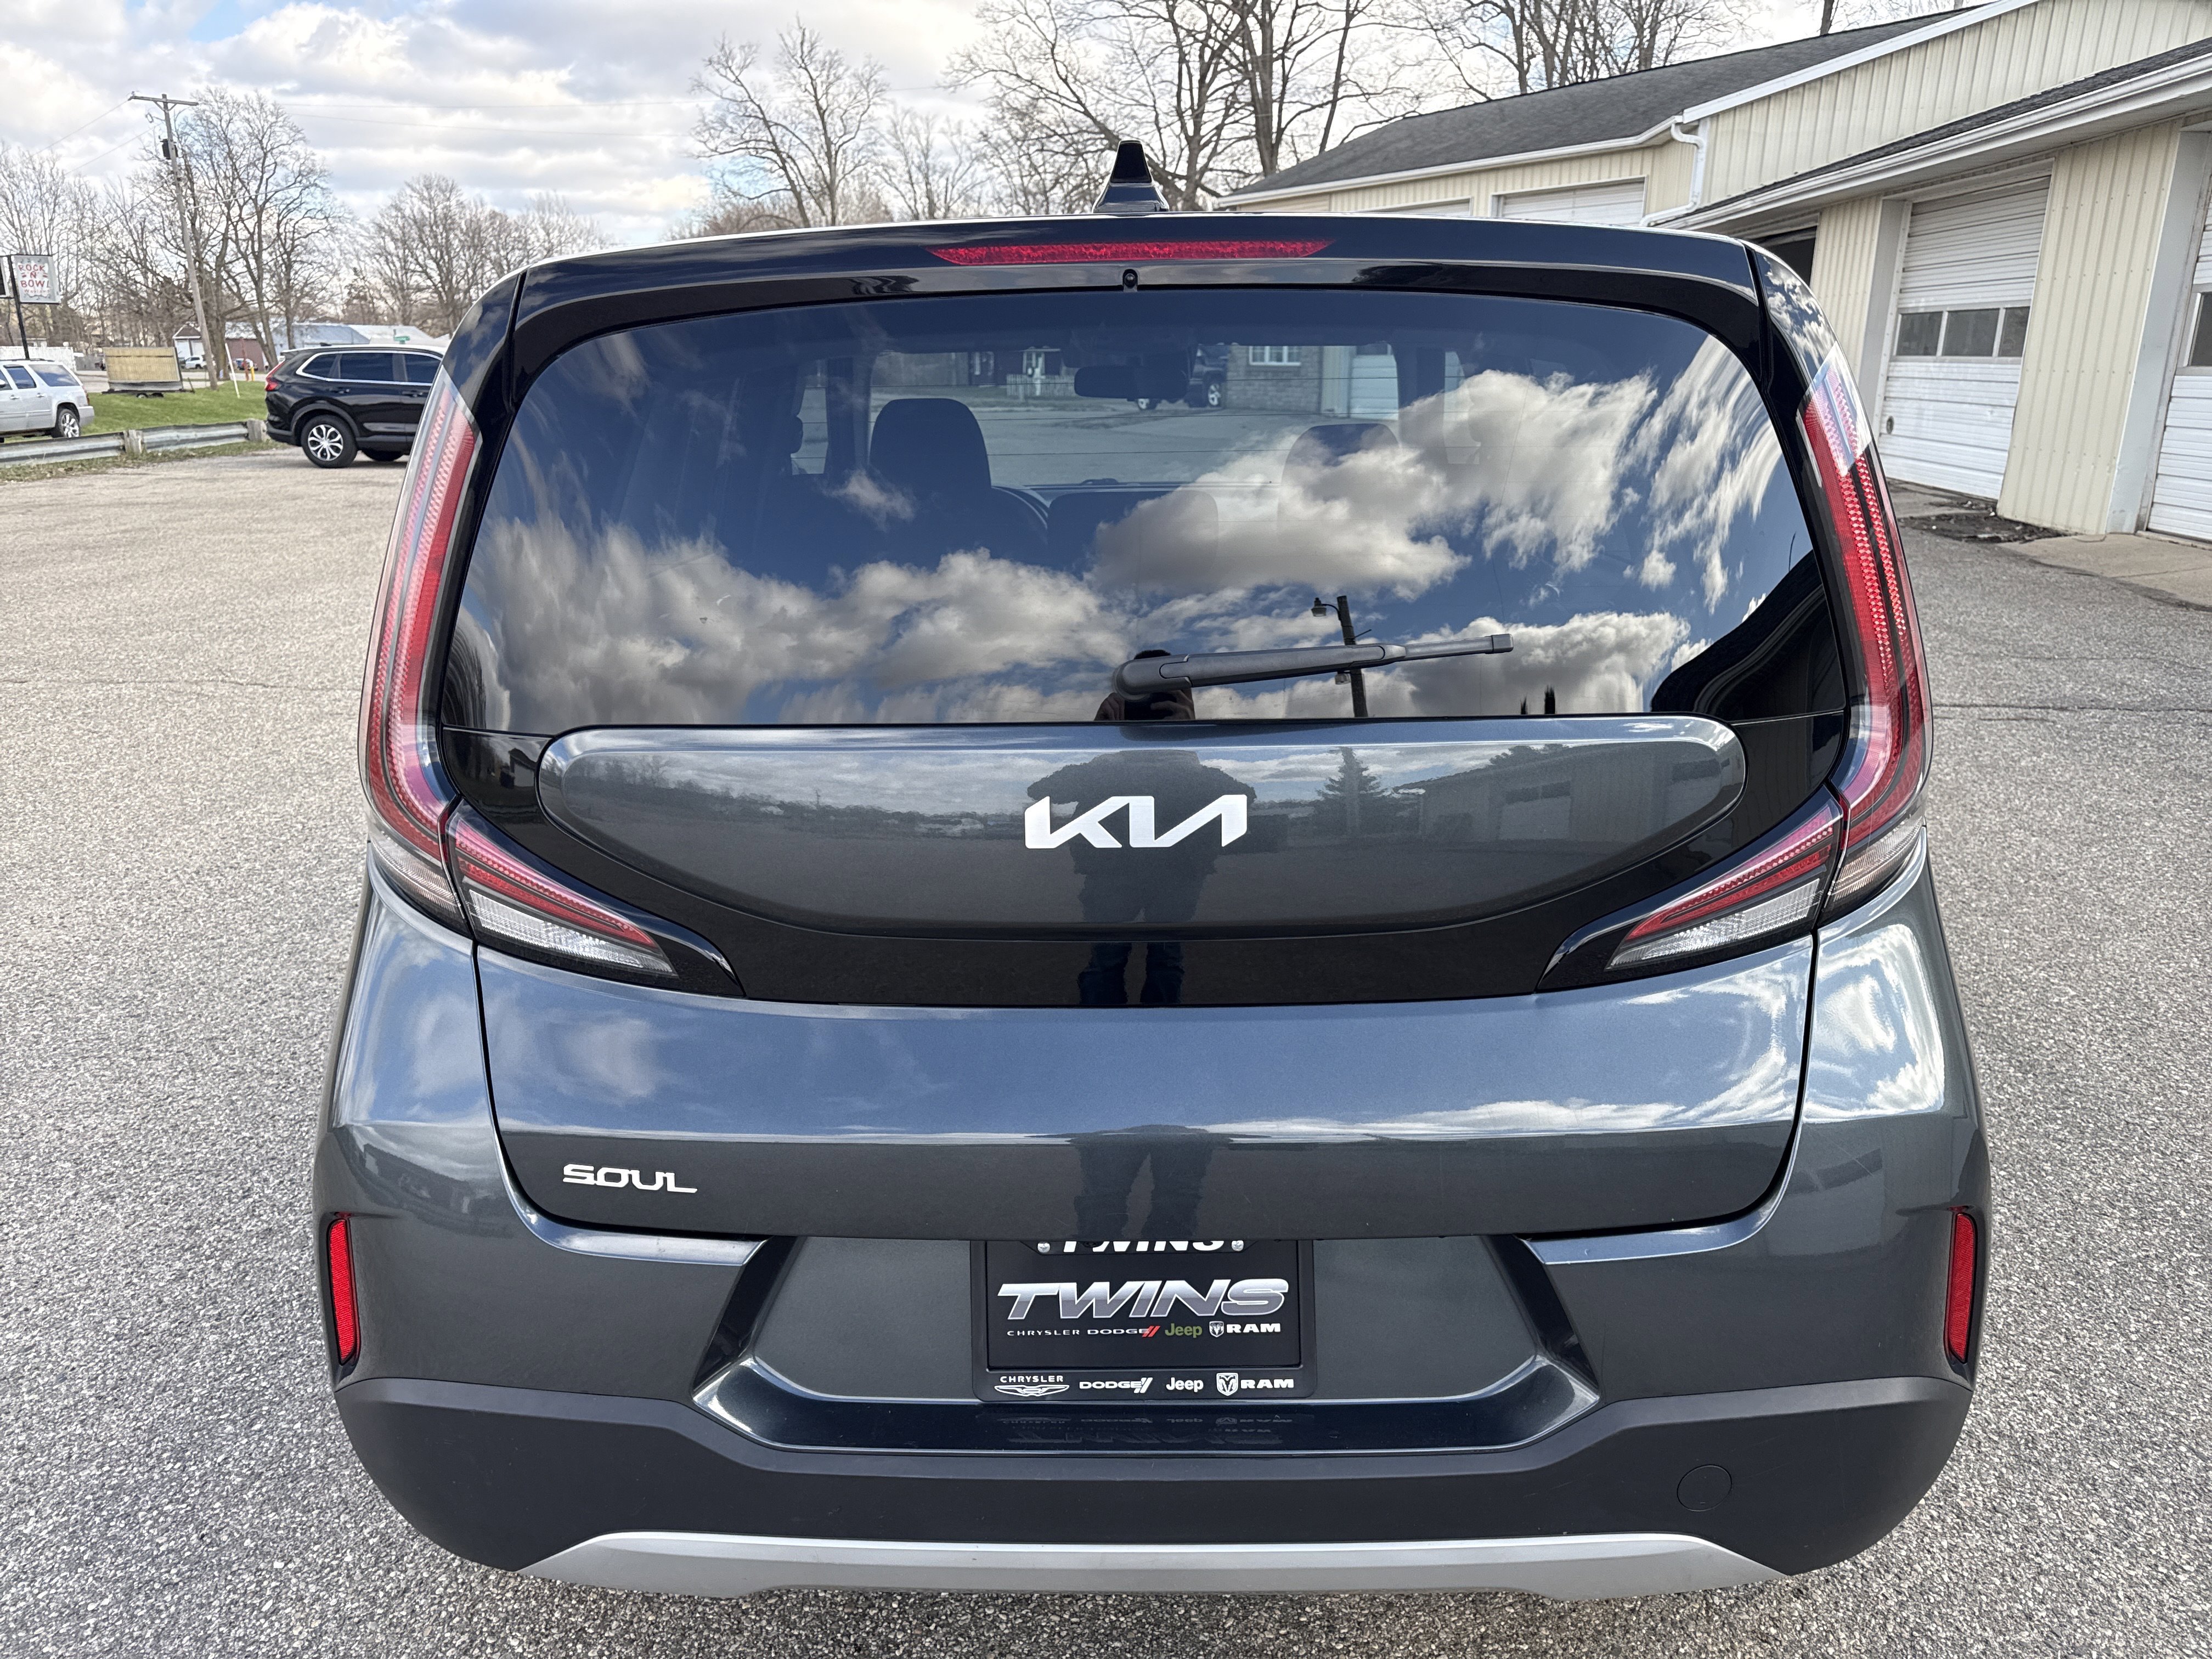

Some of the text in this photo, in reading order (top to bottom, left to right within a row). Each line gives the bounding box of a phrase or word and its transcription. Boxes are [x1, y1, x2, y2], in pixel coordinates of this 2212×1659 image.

[1024, 794, 1248, 849] KIA
[562, 1164, 698, 1193] SOUL
[997, 1278, 1289, 1320] TWINS
[1165, 1323, 1203, 1338] Jeep
[1227, 1323, 1281, 1333] RAM
[1000, 1375, 1294, 1392] CHRYSLER DODGE Jeep RAM
